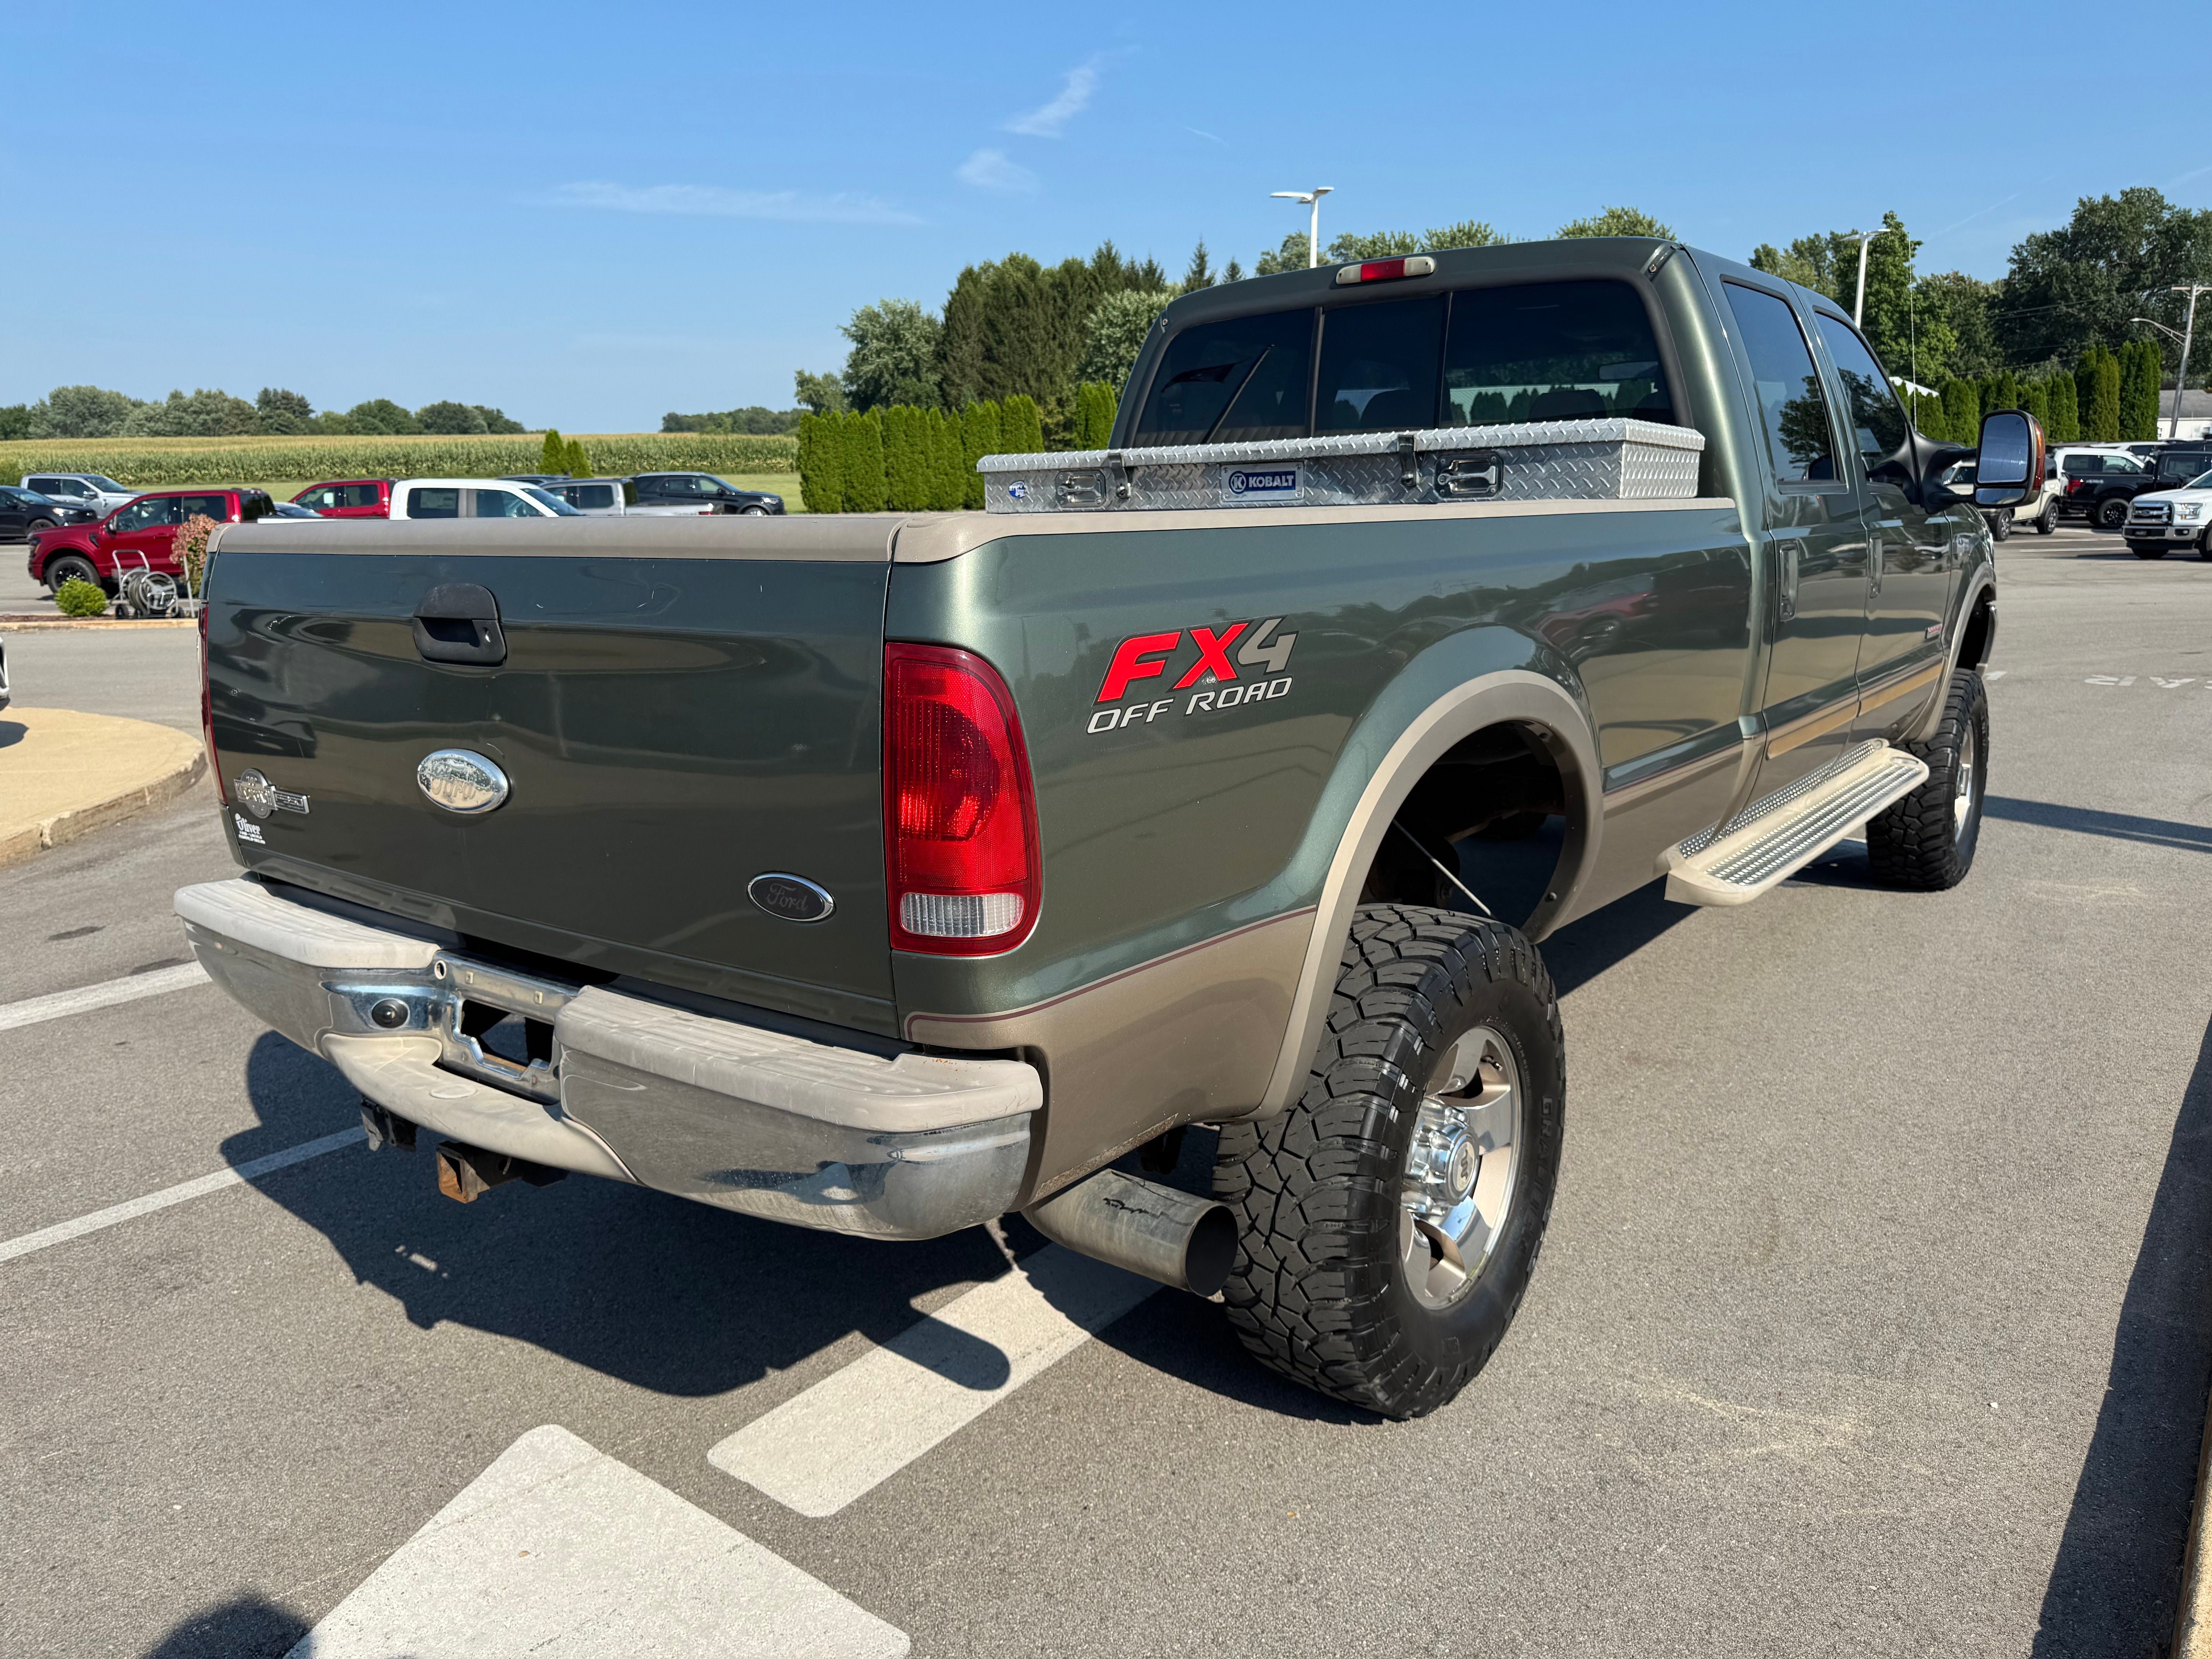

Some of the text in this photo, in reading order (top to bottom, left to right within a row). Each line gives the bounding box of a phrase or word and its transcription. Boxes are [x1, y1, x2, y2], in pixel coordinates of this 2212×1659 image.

[1249, 475, 1294, 488] KOBALT
[1097, 618, 1297, 702] FX4
[1087, 677, 1293, 734] OFF ROAD
[431, 761, 476, 799] Ford
[766, 883, 808, 911] Ford
